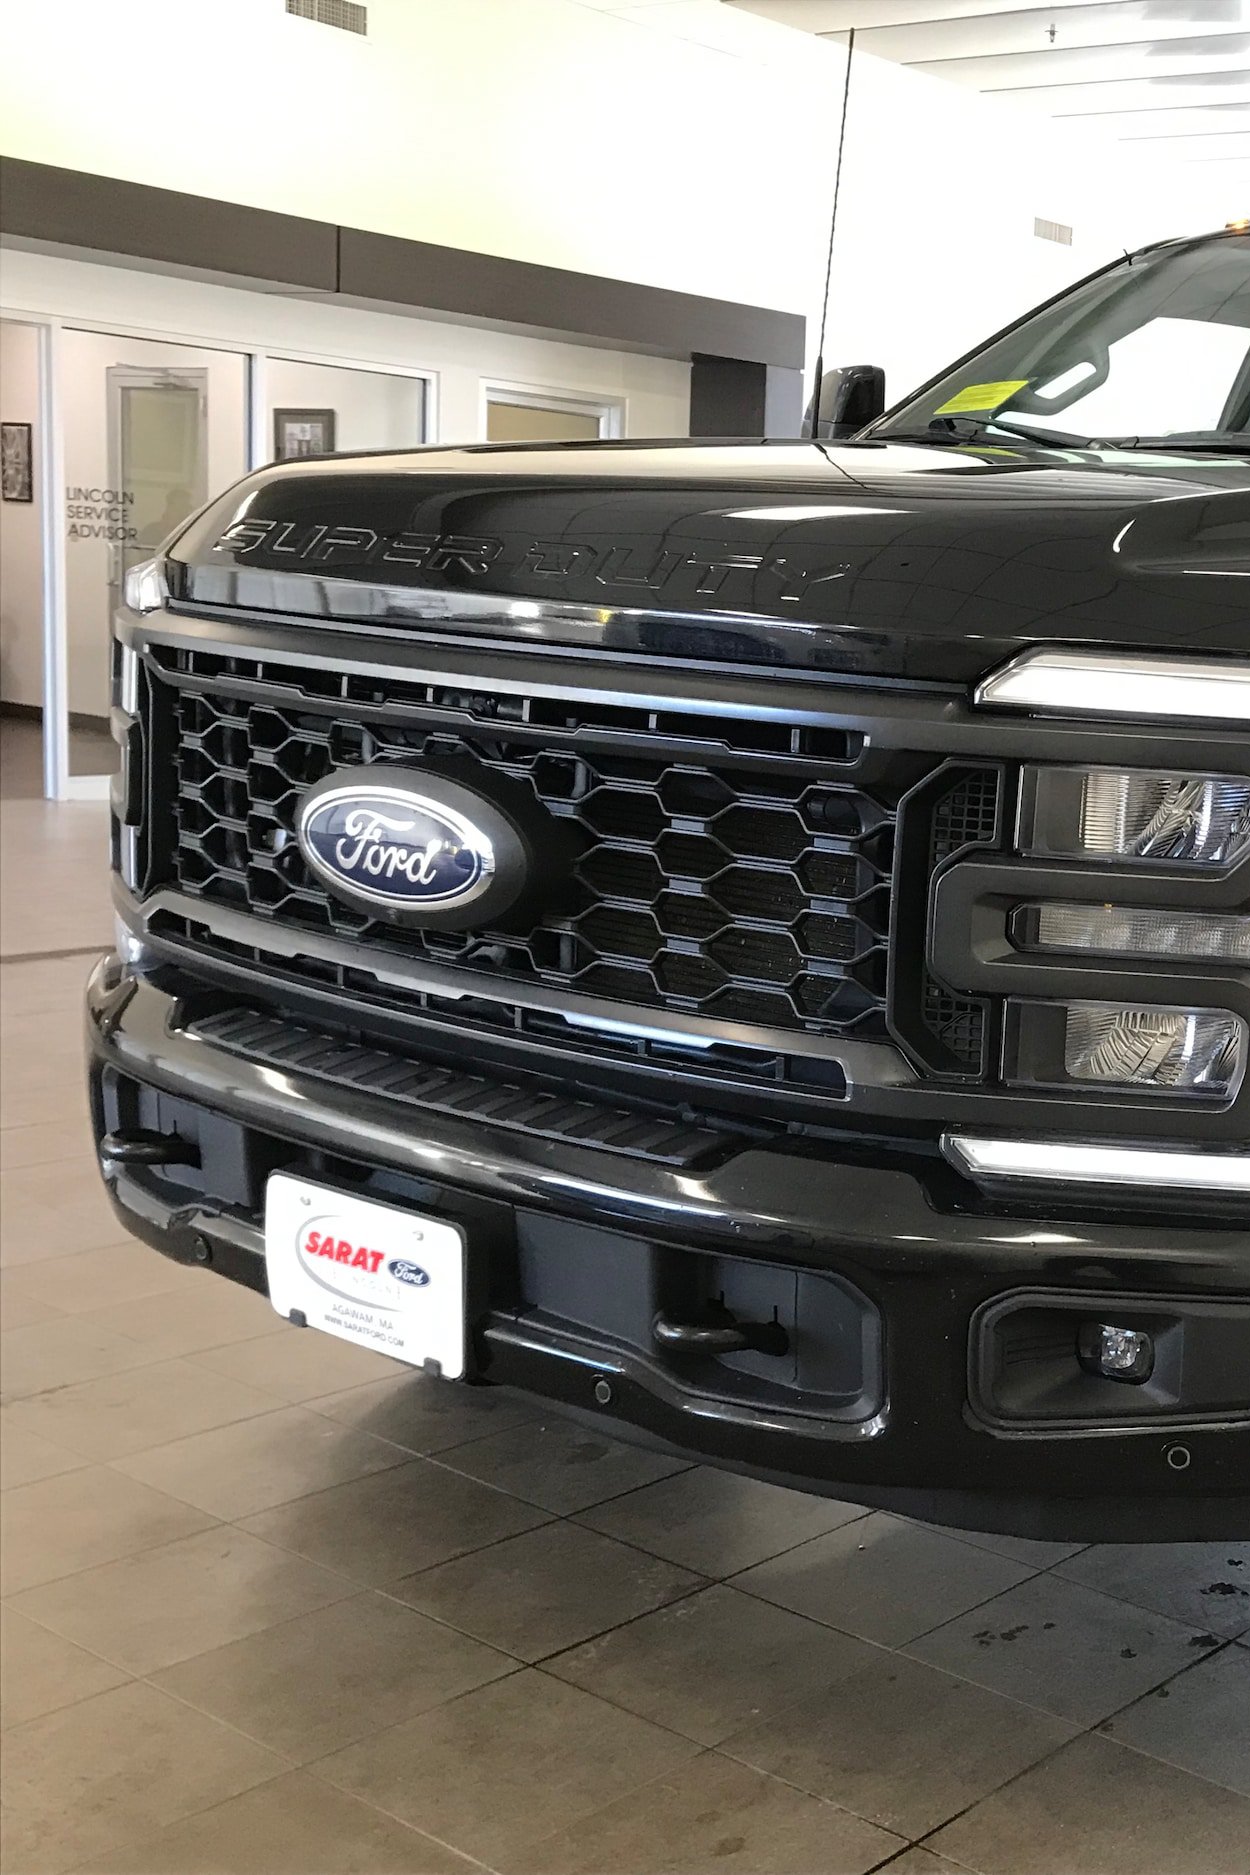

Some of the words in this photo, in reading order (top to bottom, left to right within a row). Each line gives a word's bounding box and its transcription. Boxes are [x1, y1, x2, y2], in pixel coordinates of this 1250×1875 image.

[65, 487, 134, 504] LINCOLN
[66, 504, 128, 523] SERVICE
[67, 524, 138, 541] ADVISOR
[213, 518, 503, 574] SUPER
[511, 540, 851, 601] DUTY
[336, 809, 442, 885] Ford
[304, 1231, 385, 1274] SARAT
[394, 1262, 424, 1285] Ford
